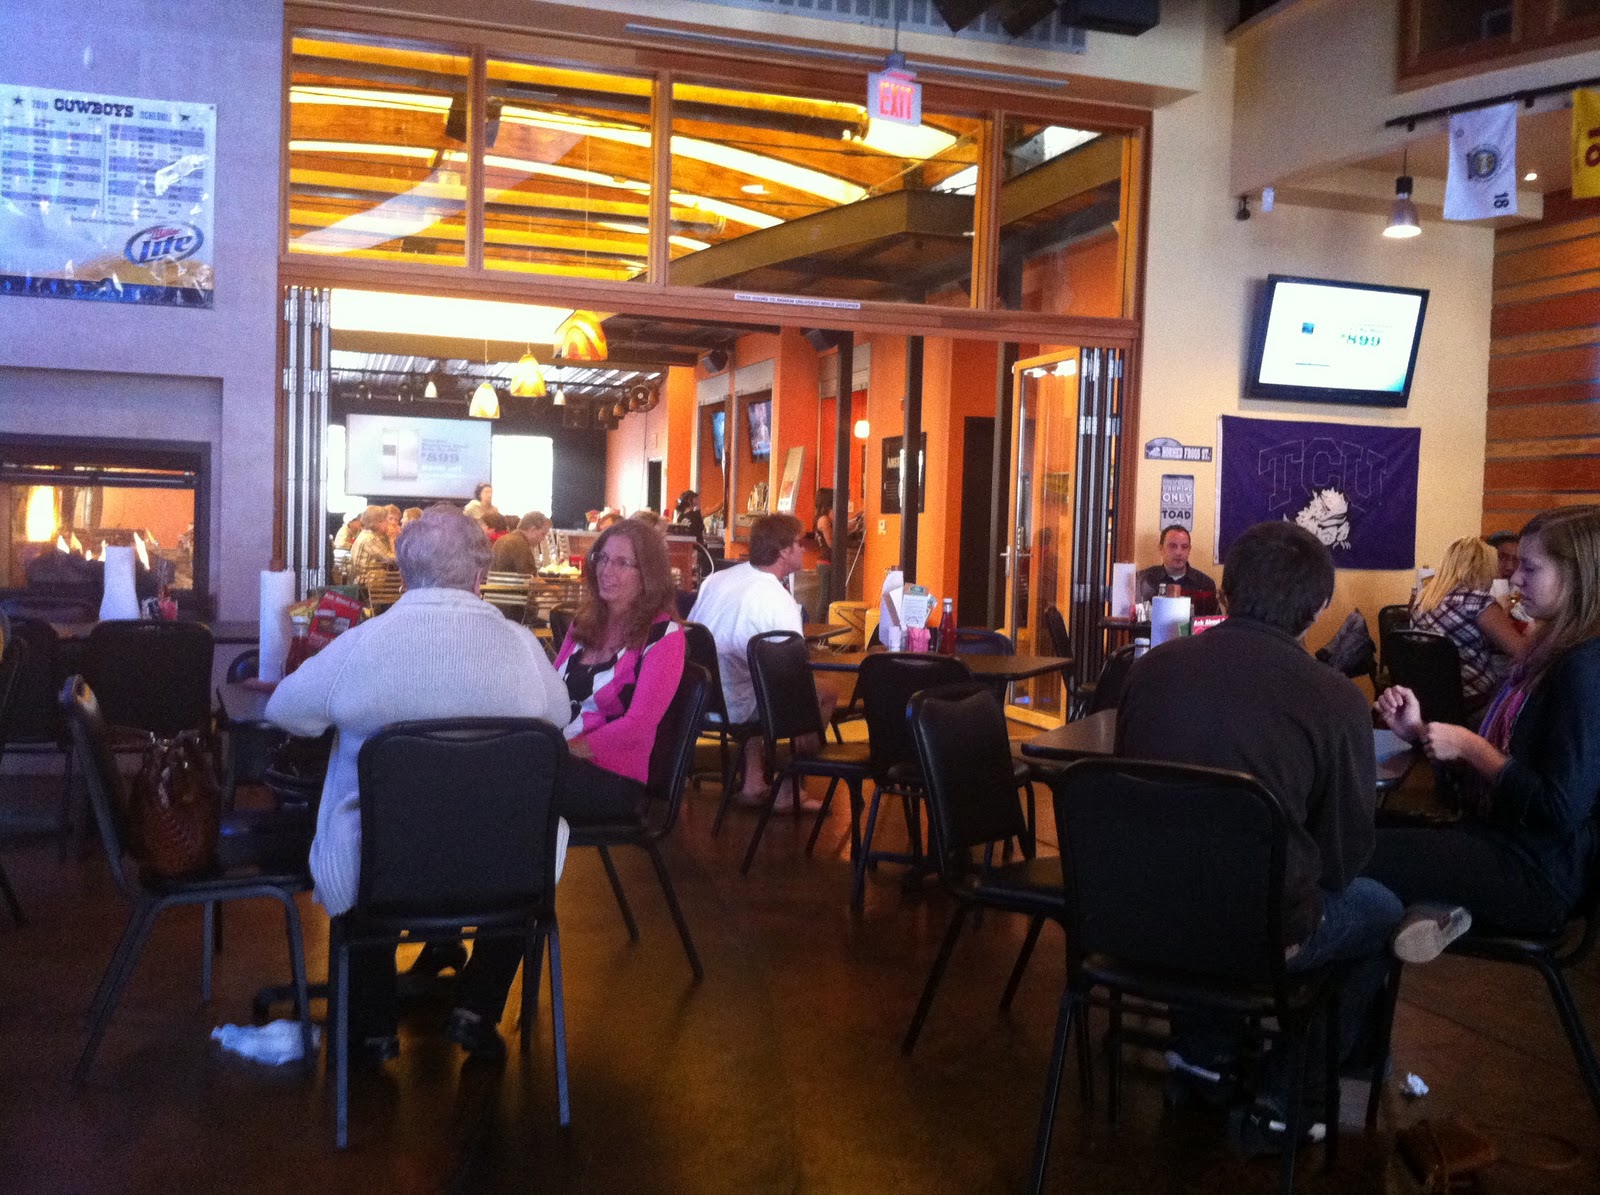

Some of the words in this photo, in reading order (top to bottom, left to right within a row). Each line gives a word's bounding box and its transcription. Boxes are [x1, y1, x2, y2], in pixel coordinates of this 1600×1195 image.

[54, 98, 134, 118] COWBOYS
[880, 82, 916, 120] EXIT
[139, 235, 193, 263] Lite
[1340, 333, 1381, 348] 899
[1257, 437, 1388, 512] TCU
[1162, 492, 1192, 504] ONLY
[1161, 510, 1191, 520] TOAD
